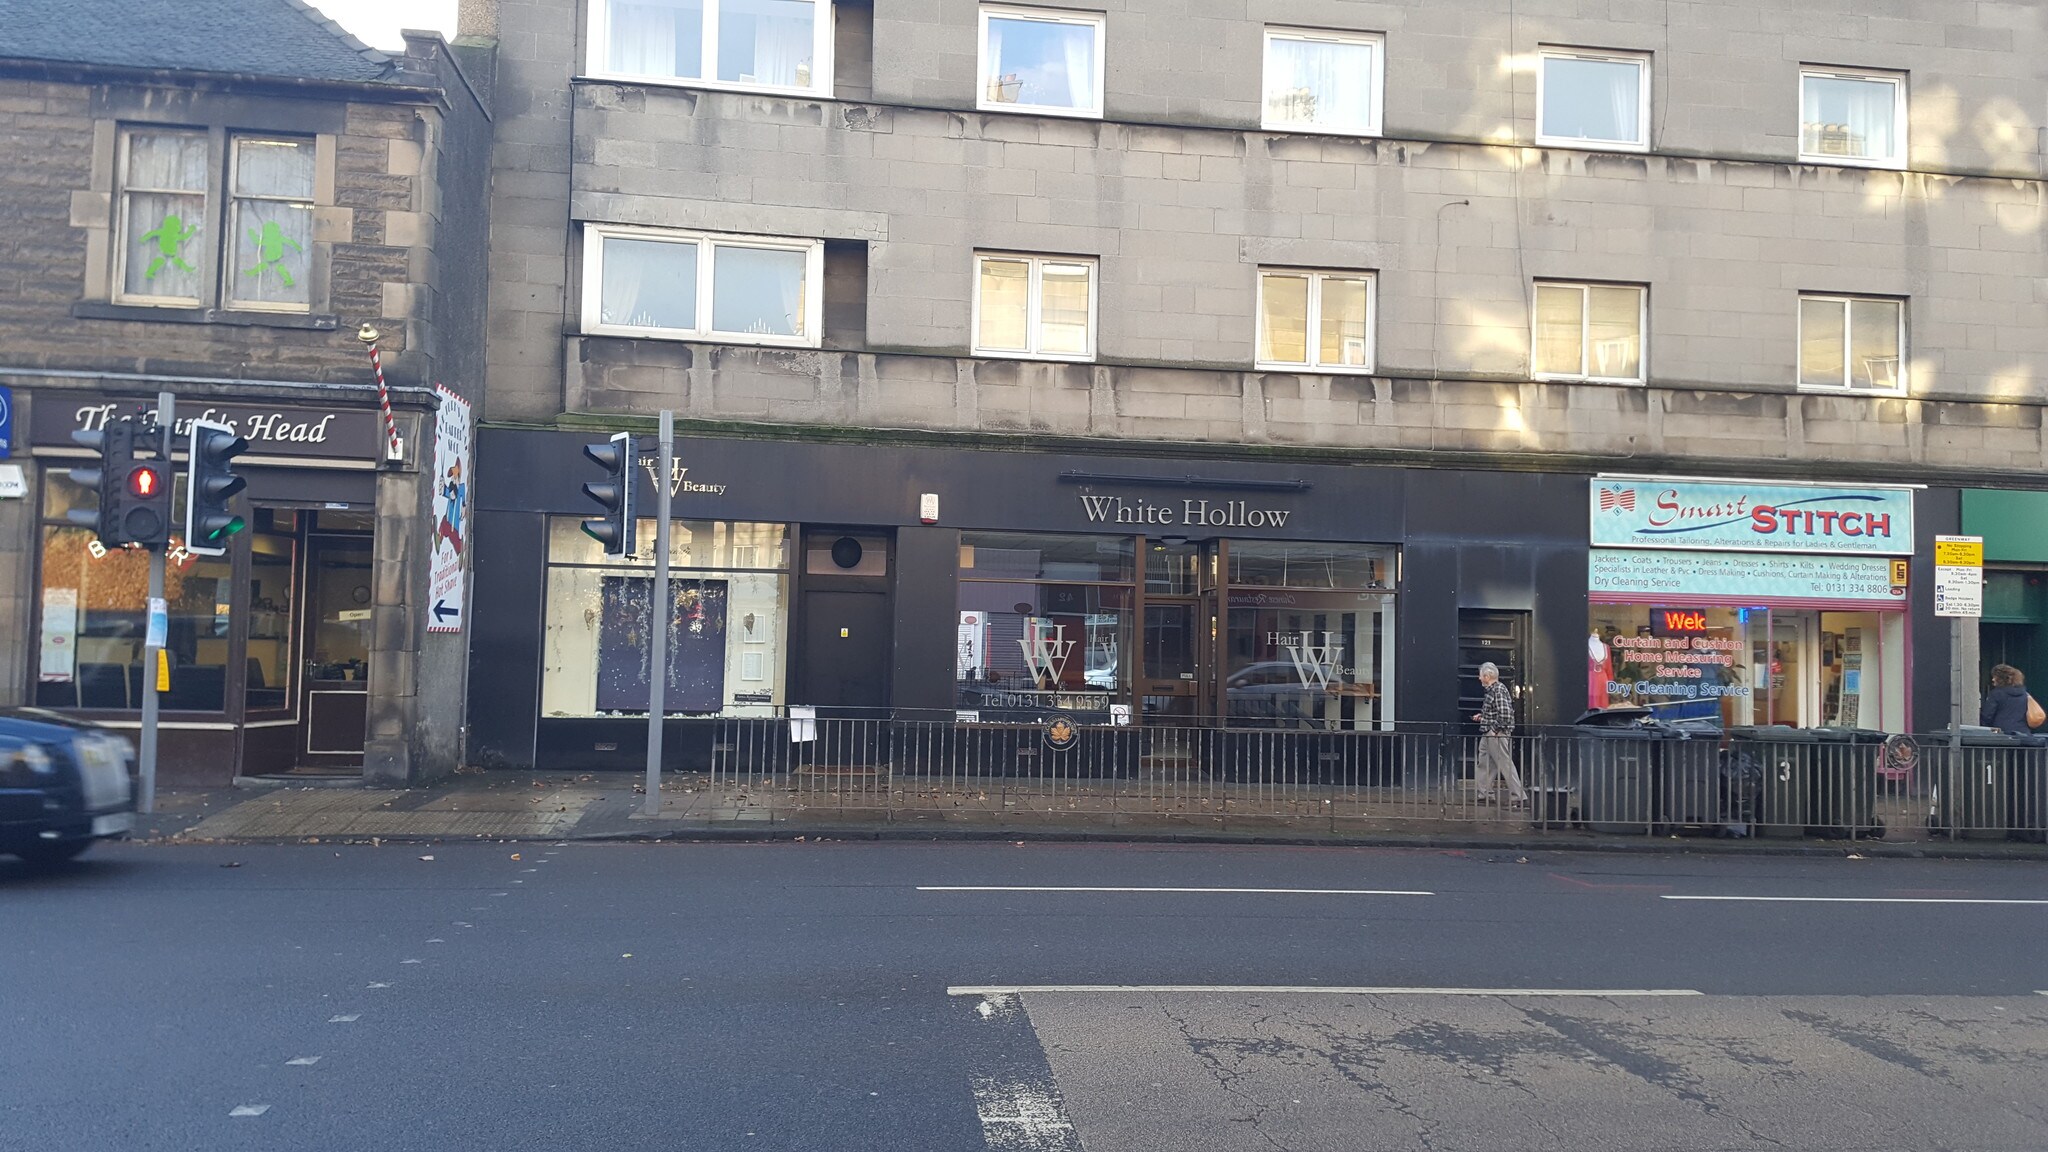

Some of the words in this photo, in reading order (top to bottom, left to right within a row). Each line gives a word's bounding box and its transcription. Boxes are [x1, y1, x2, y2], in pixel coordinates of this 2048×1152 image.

[244, 413, 335, 443] Head
[683, 481, 726, 496] Beauty
[1080, 495, 1173, 524] White
[1182, 499, 1290, 528] Hollow
[1648, 489, 1747, 526] Smart
[1751, 505, 1891, 537] STITCH
[1632, 536, 1676, 544] Professional
[1678, 537, 1711, 546] Tailoring,
[1715, 538, 1755, 546] Alterations
[1765, 539, 1791, 548] Repairs
[1806, 540, 1827, 548] Ladies
[1838, 541, 1877, 549] Gentleman
[1595, 555, 1619, 563] Jackets
[1632, 556, 1652, 564] Coats
[1663, 557, 1691, 565] Trousers
[1702, 558, 1721, 566] Jeans
[1733, 559, 1758, 567] Dresses
[1770, 560, 1789, 569] Shirts
[1800, 561, 1814, 569] Kilts
[1829, 562, 1859, 572] Wedding
[1862, 563, 1886, 572] Dresses
[1594, 565, 1631, 574] Specialists
[1699, 568, 1717, 576] Dress
[1720, 569, 1745, 578] Making
[1753, 570, 1786, 578] Cushions,
[1788, 571, 1813, 579] Curtain
[1815, 572, 1840, 581] Making
[1843, 572, 1848, 580] &
[1850, 573, 1887, 581] Alterations
[1594, 577, 1609, 587] Dry
[1612, 577, 1648, 588] Cleaning
[1652, 578, 1680, 587] Service
[1811, 583, 1823, 592] Tel:
[1826, 583, 1846, 592] 0131
[1849, 584, 1864, 593] 334
[1867, 585, 1887, 593] 8806
[1665, 611, 1706, 630] Welc
[1267, 631, 1298, 645] Hair
[1613, 635, 1661, 649] Curtain
[1664, 637, 1689, 649] and
[1691, 637, 1744, 650] Cushion
[1624, 651, 1663, 663] Home
[1666, 651, 1733, 667] Measuring
[1656, 665, 1702, 678] Service
[1607, 681, 1632, 697] Dry
[1635, 681, 1697, 698] Cleaning
[1700, 683, 1749, 696] Service
[981, 693, 1003, 707] Tel
[1007, 694, 1040, 707] 0131
[1047, 695, 1070, 708] 334
[1075, 695, 1109, 709] 9559
[1779, 761, 1790, 782] 3
[1986, 765, 1992, 785] 1
